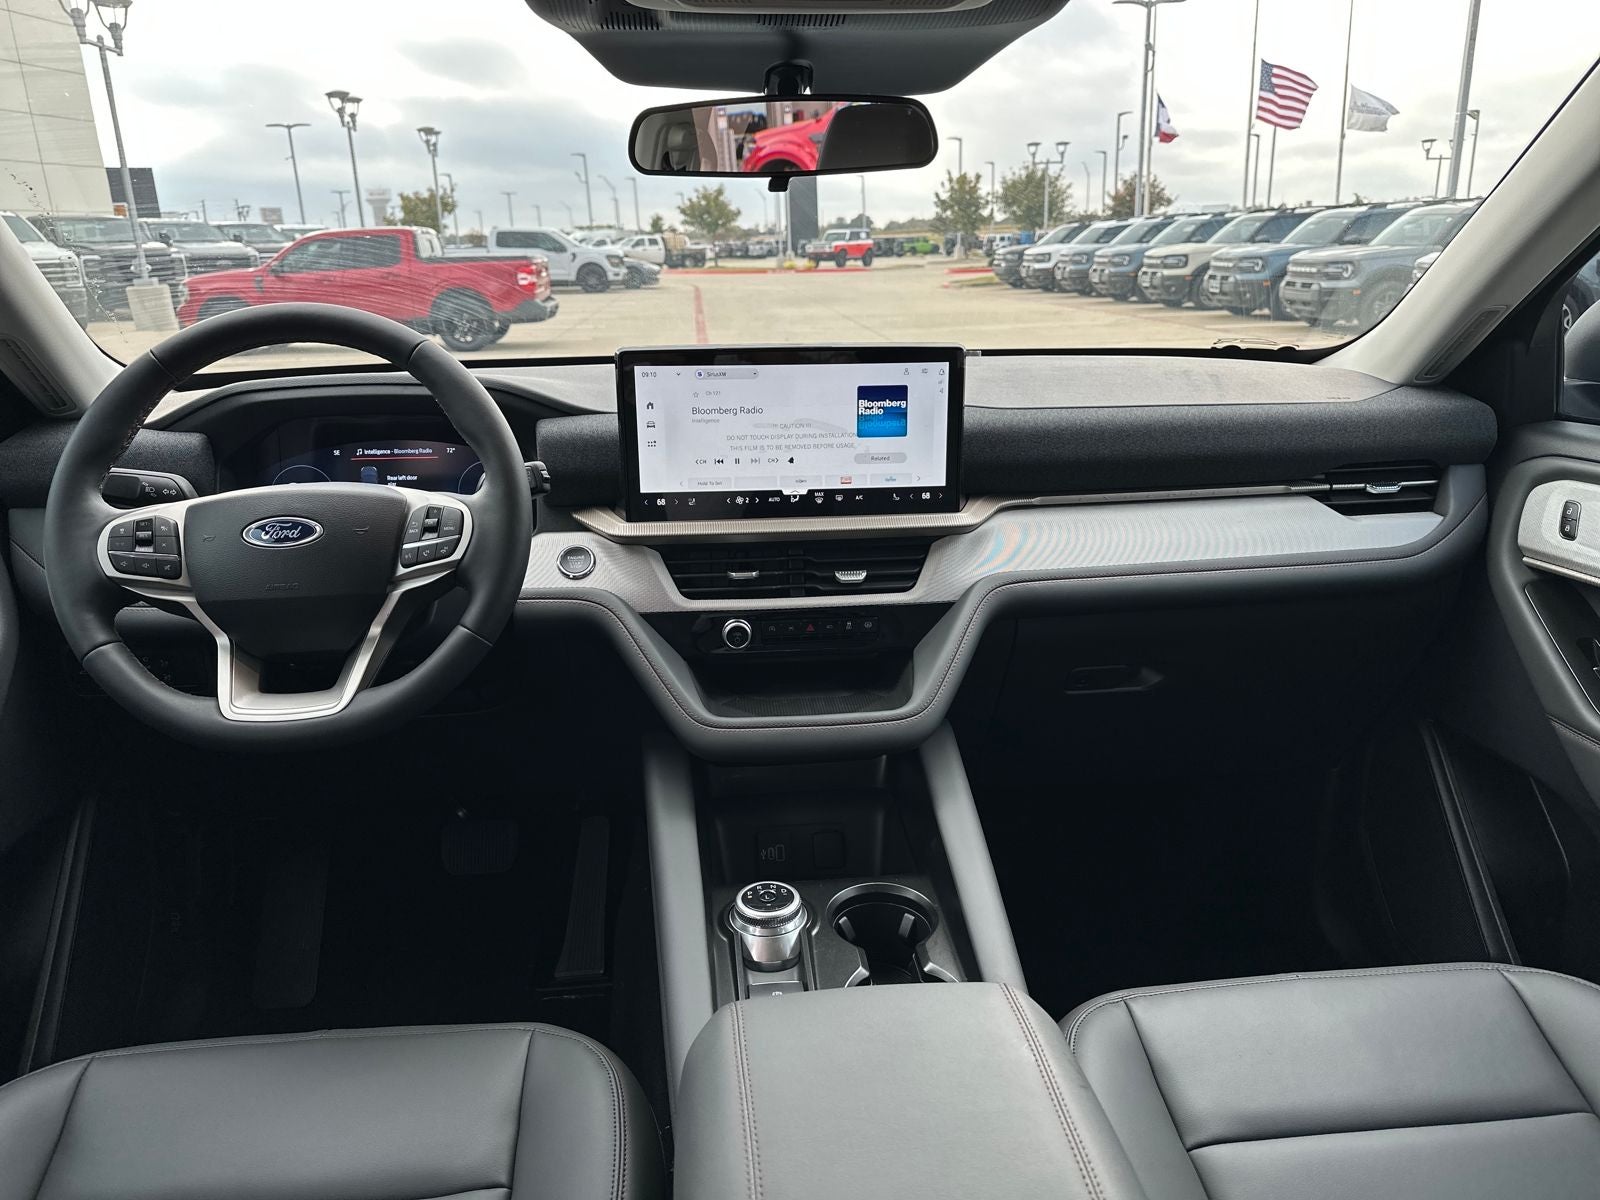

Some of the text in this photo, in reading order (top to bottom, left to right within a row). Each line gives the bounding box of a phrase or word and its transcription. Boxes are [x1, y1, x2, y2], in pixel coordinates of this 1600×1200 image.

[859, 399, 907, 408] Bloomberg
[691, 406, 764, 416] Bloomberg Radio
[858, 407, 884, 415] Radio
[921, 492, 931, 500] 68
[656, 498, 666, 506] 68
[261, 522, 302, 540] Ford
